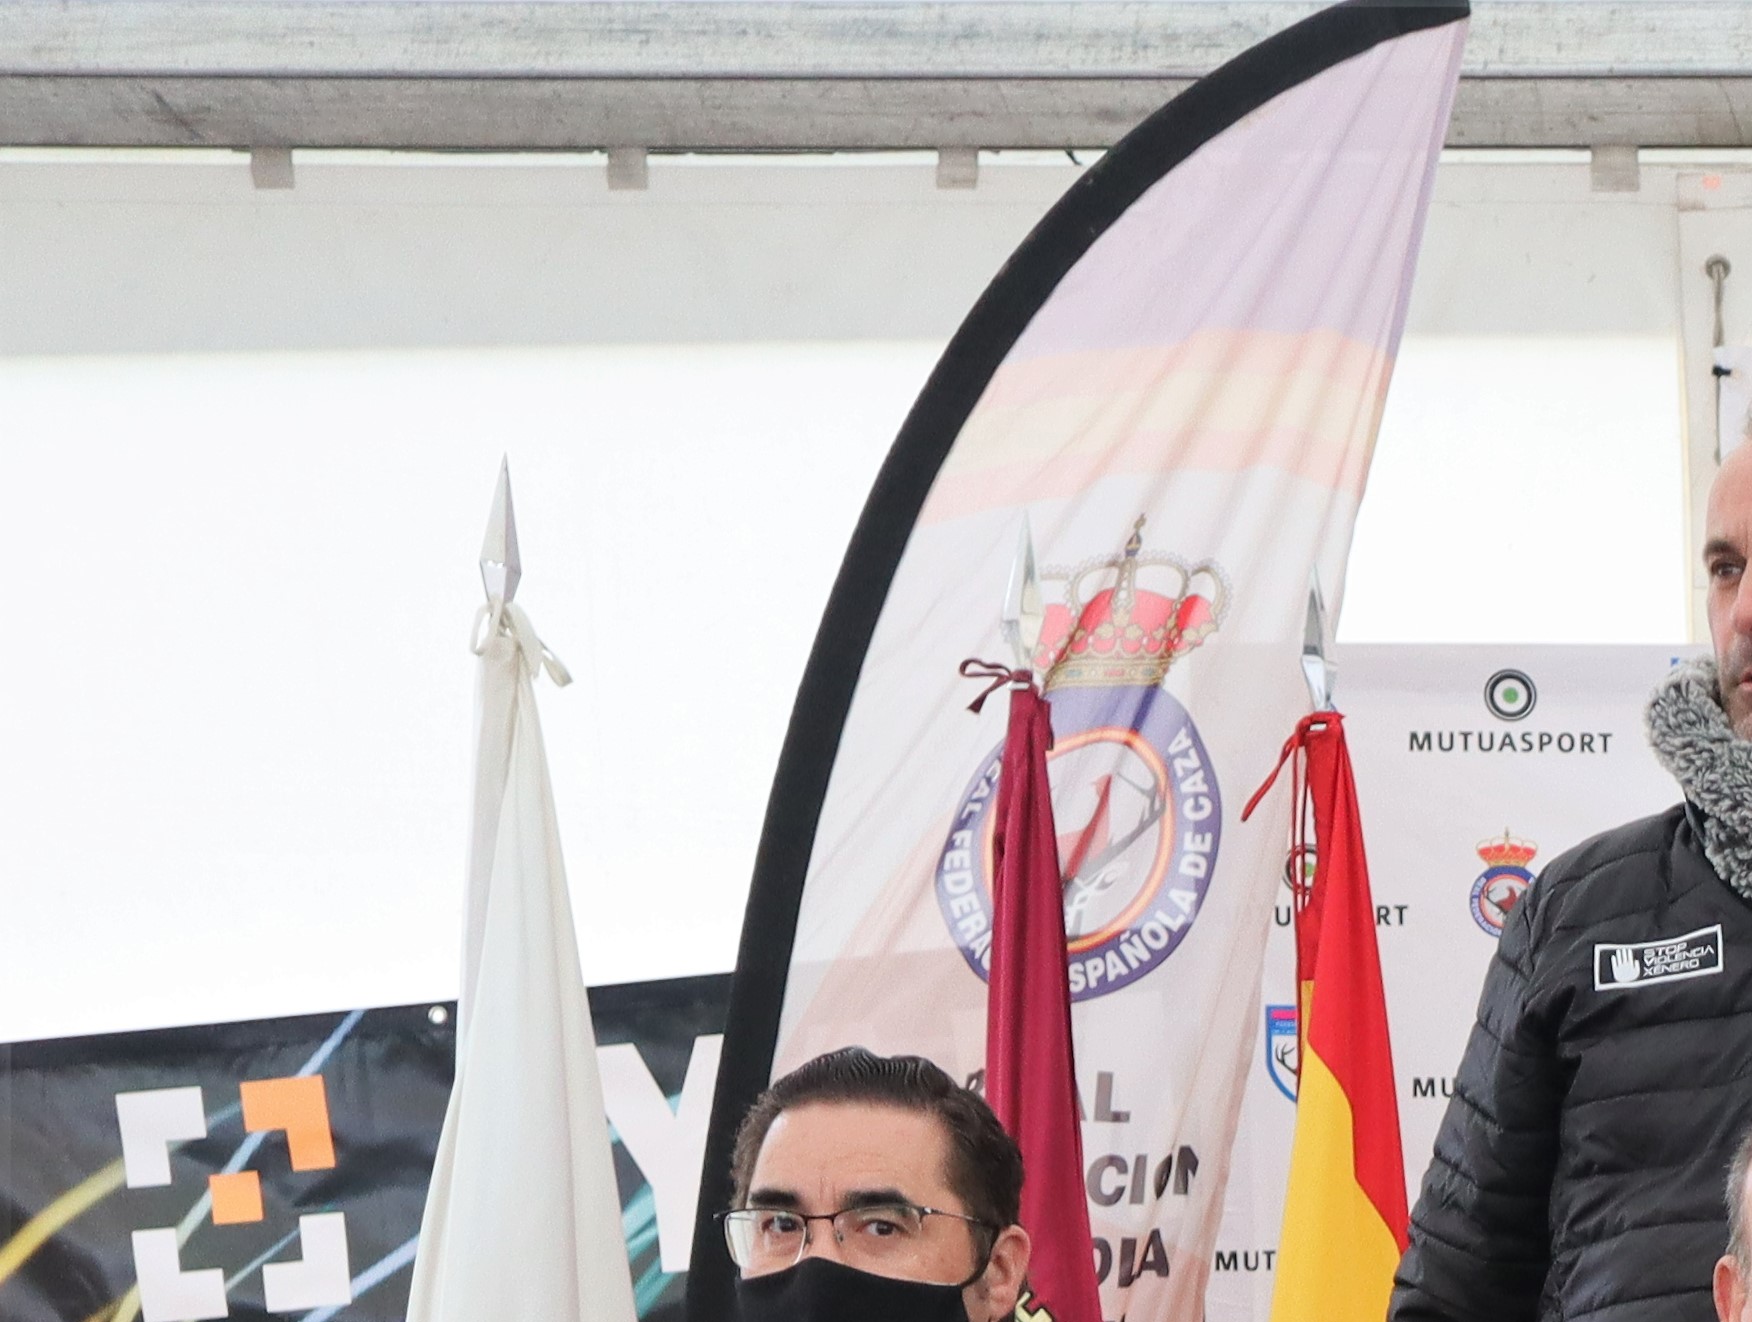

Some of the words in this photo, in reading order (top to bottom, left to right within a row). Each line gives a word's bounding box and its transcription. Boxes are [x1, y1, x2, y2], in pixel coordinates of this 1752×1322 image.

[1409, 731, 1612, 754] MUTUASPORT
[959, 758, 1001, 824] EAL
[1179, 832, 1213, 878] DE
[945, 829, 992, 970] FEDERA
[1068, 888, 1197, 993] SPAÑOLA
[1643, 942, 1688, 958] STOP
[1644, 945, 1714, 966] VIOLENCIA
